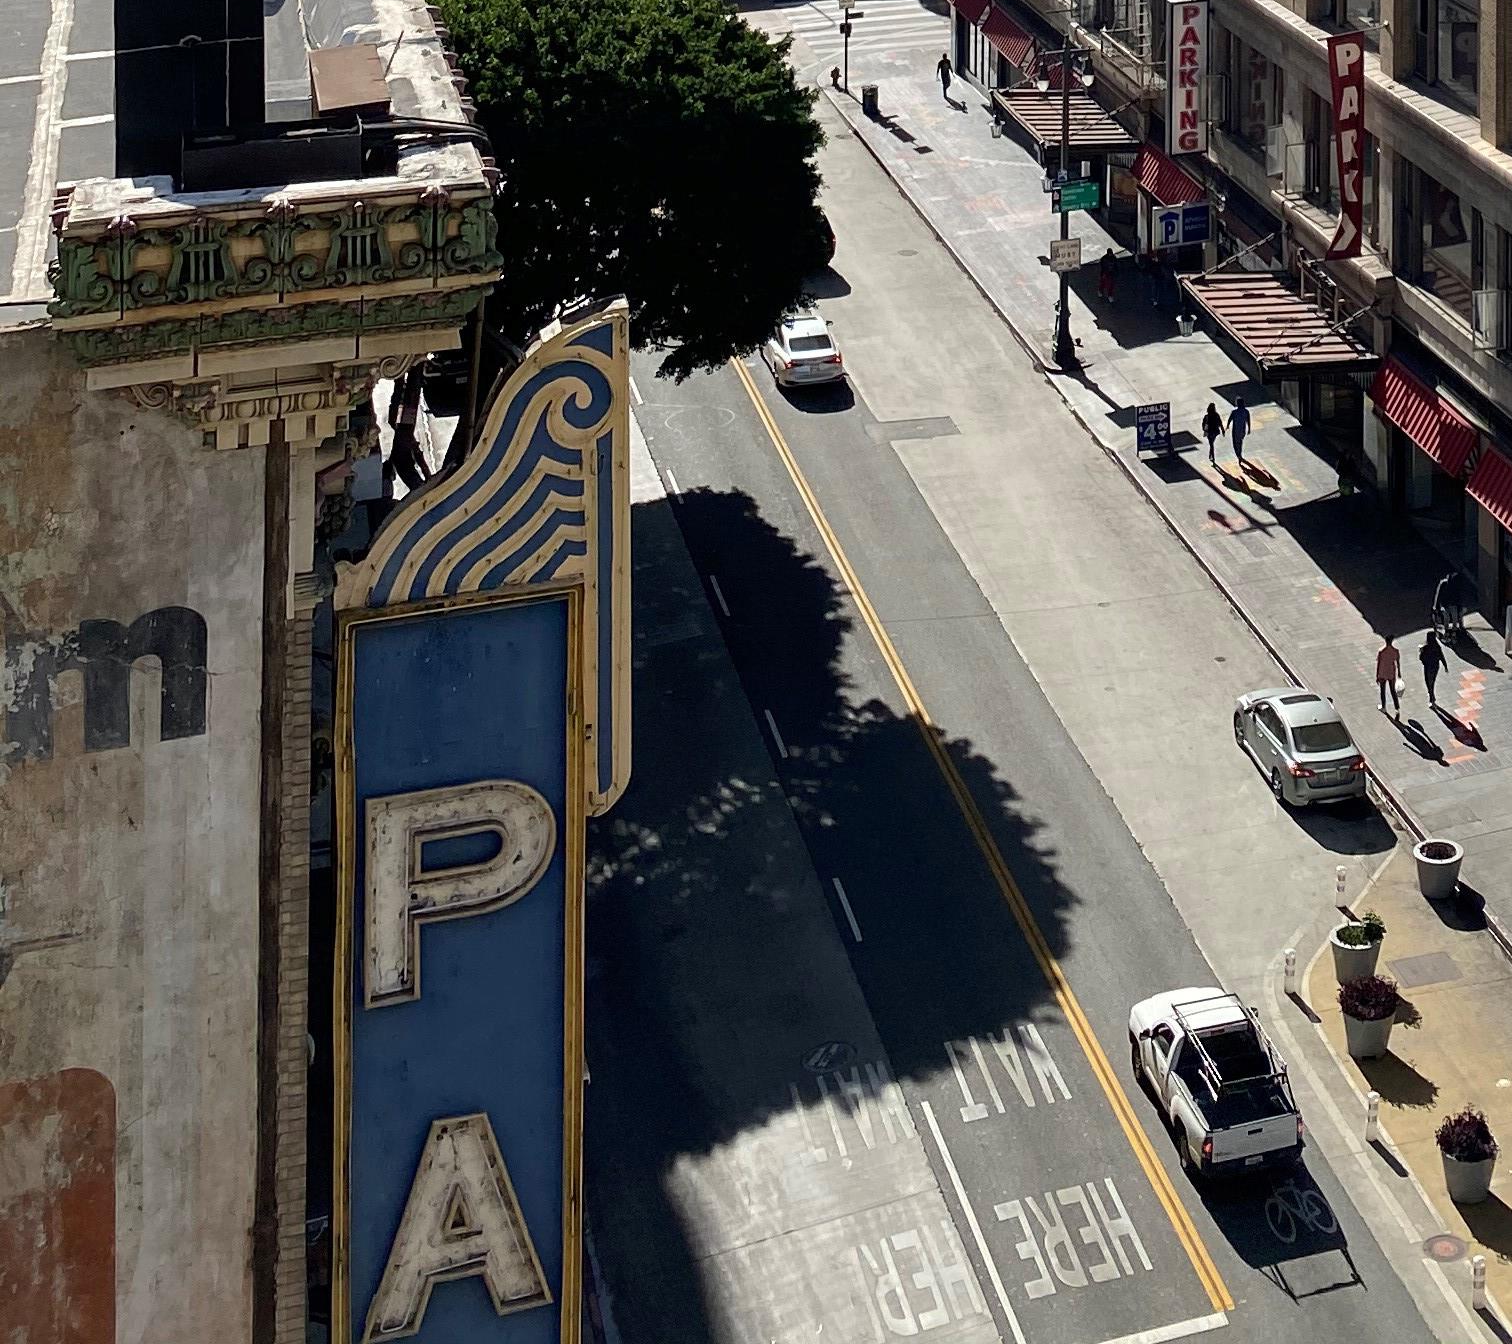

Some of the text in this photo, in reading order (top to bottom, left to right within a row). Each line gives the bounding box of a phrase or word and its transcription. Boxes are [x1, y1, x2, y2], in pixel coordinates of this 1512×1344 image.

[1178, 5, 1200, 151] PARKING
[1335, 43, 1361, 202] PARK
[1138, 403, 1168, 414] PUBLIC
[944, 1023, 1073, 1123] WAIT
[993, 1177, 1154, 1301] HERE
